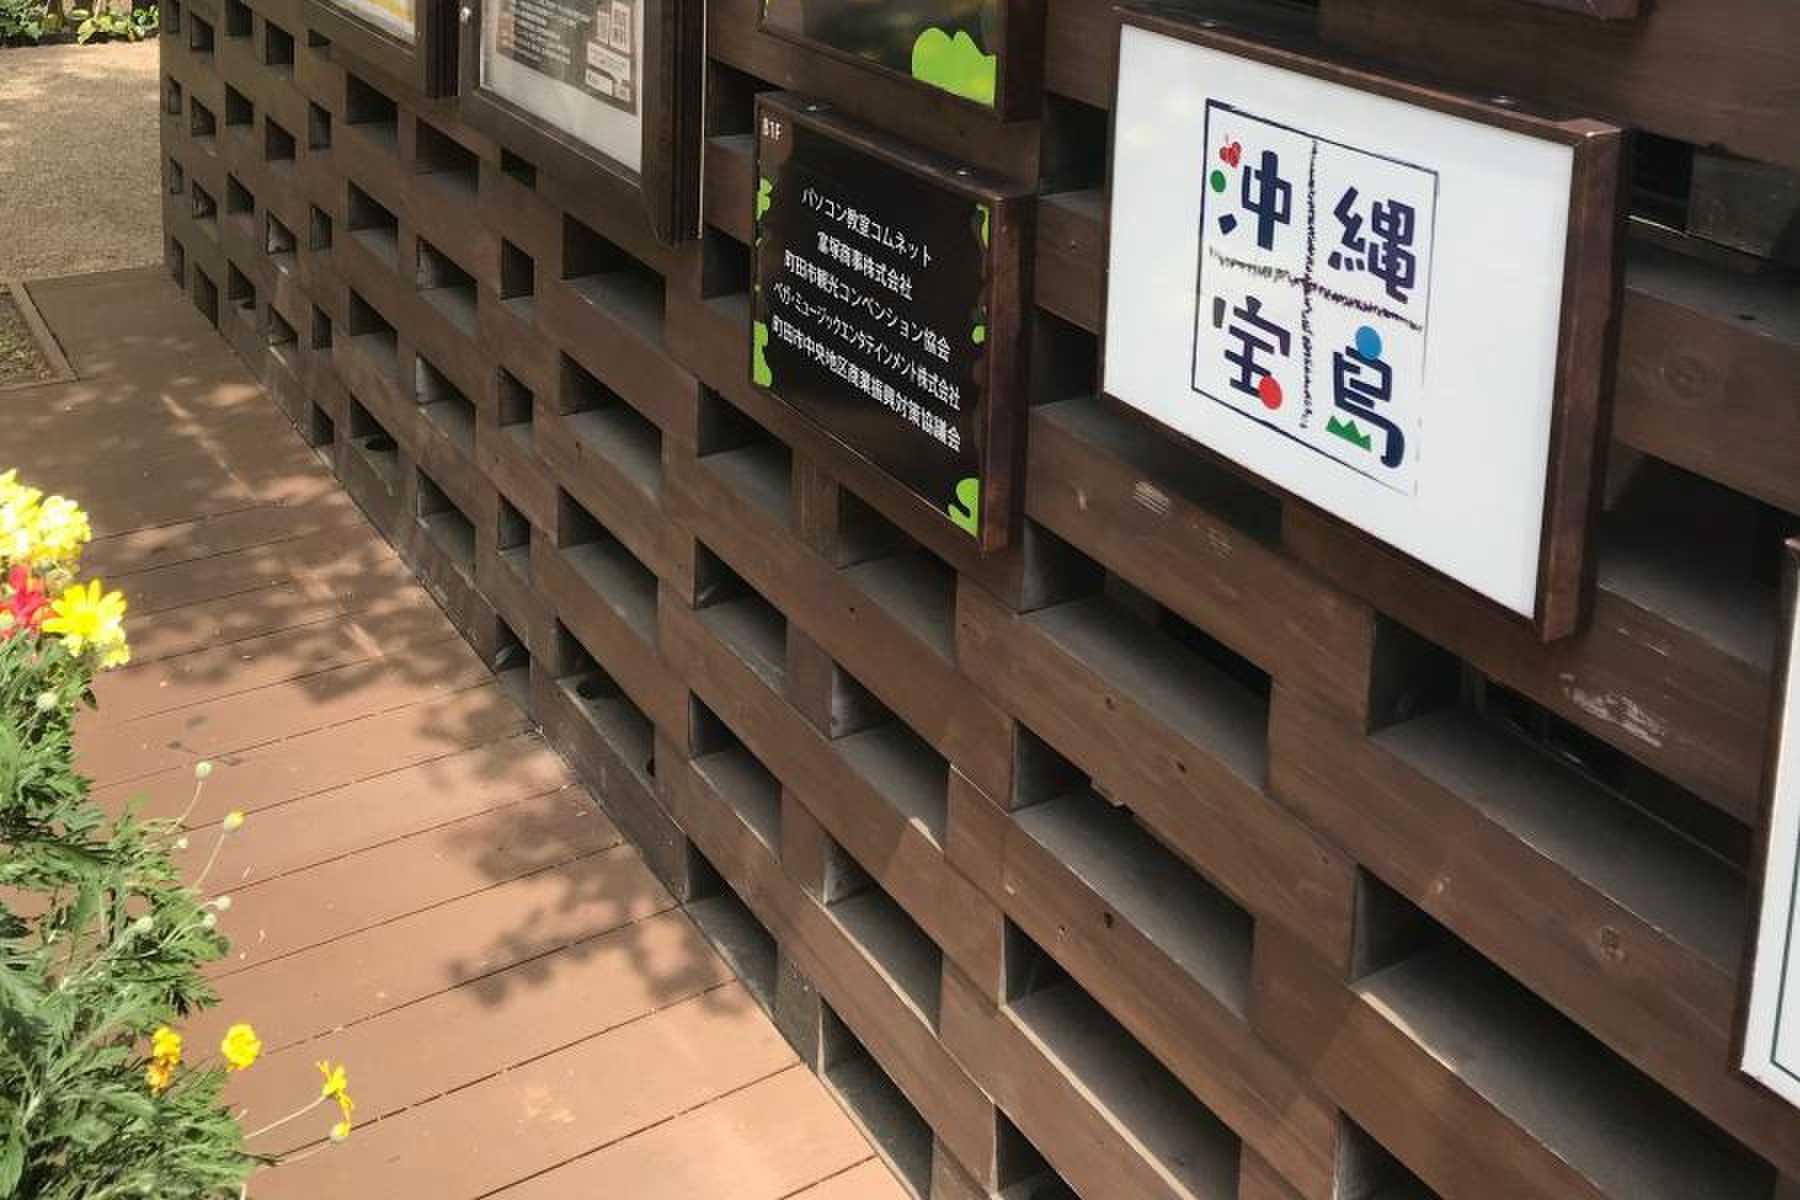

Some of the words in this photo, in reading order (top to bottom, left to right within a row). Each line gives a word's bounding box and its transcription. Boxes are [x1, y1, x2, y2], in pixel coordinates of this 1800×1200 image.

[802, 187, 932, 268] パソコン教室コムネット
[783, 249, 951, 362] 町田市観光コンベンション協会
